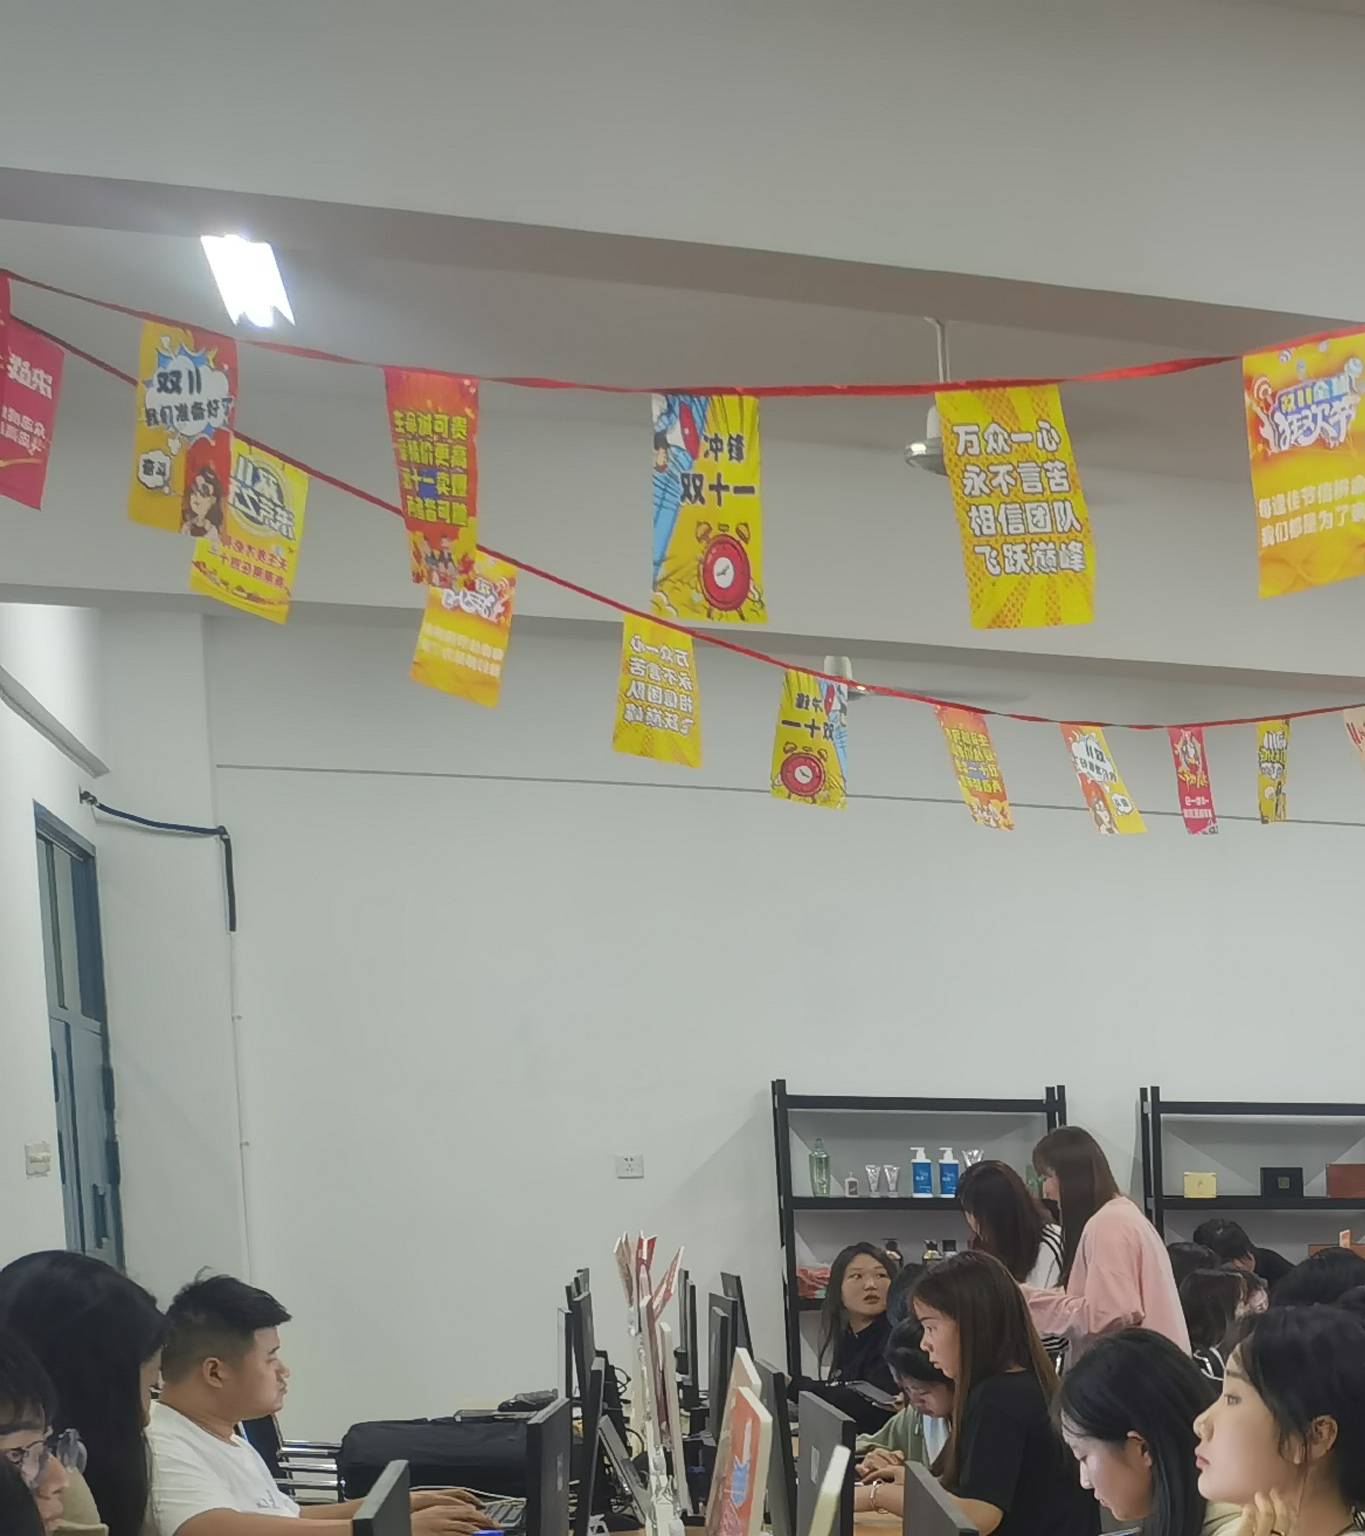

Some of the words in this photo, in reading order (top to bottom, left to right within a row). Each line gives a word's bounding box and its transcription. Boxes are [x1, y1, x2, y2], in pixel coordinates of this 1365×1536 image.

[156, 369, 203, 396] 双11
[145, 396, 234, 427] 我们准备好了
[702, 432, 747, 464] 冲锋
[953, 419, 1061, 457] 万众一心
[681, 472, 756, 507] 双十一
[963, 460, 1071, 497] 永不言苦
[968, 501, 1083, 537] 相信团队
[975, 541, 1088, 577] 飞跃巅峰
